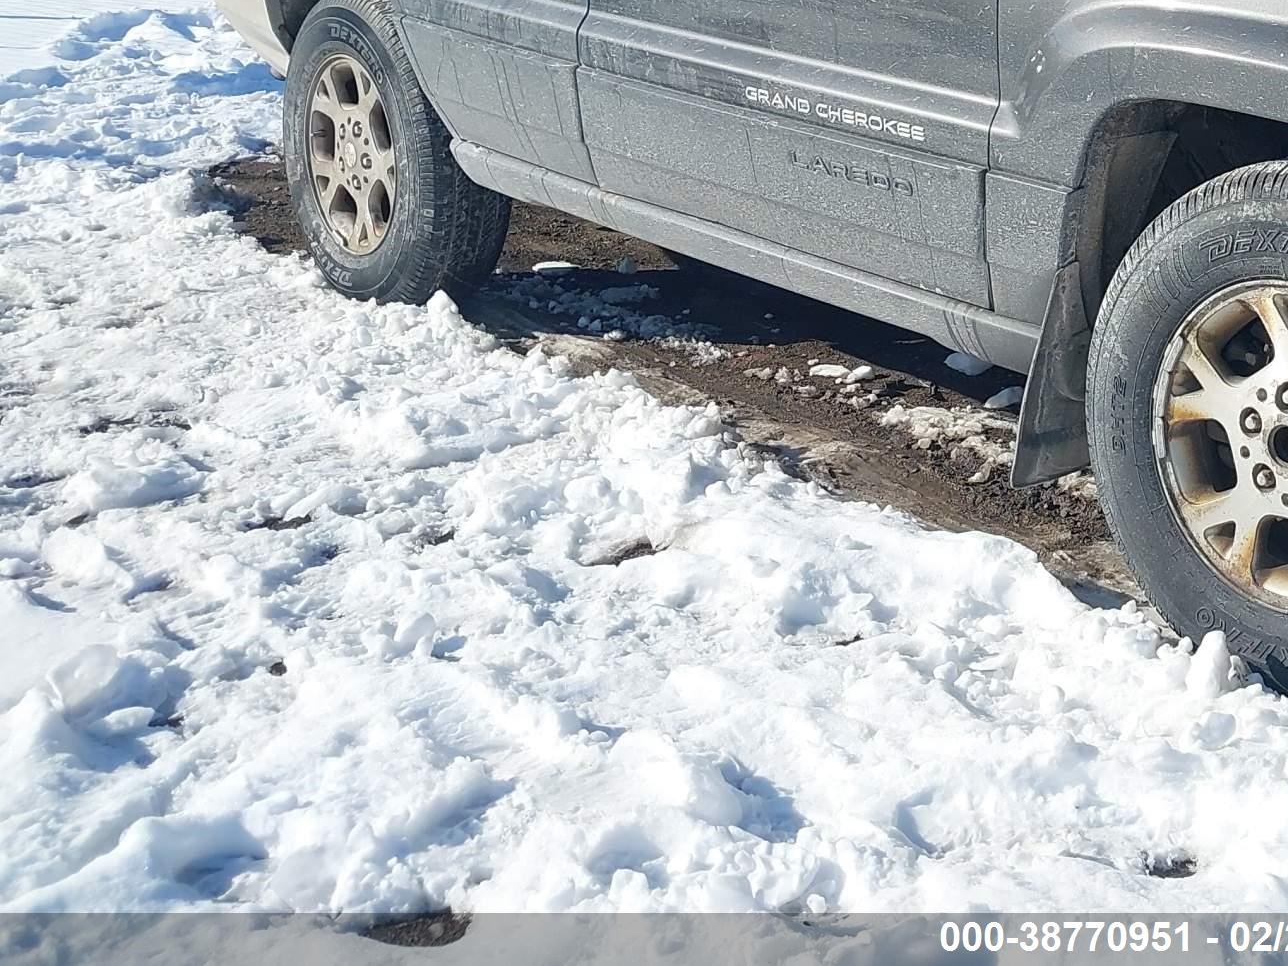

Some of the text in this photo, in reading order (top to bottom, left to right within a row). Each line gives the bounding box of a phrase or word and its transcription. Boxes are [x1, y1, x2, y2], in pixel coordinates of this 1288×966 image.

[744, 86, 926, 142] GRAND CHEROKEE
[791, 149, 915, 198] LAREDO
